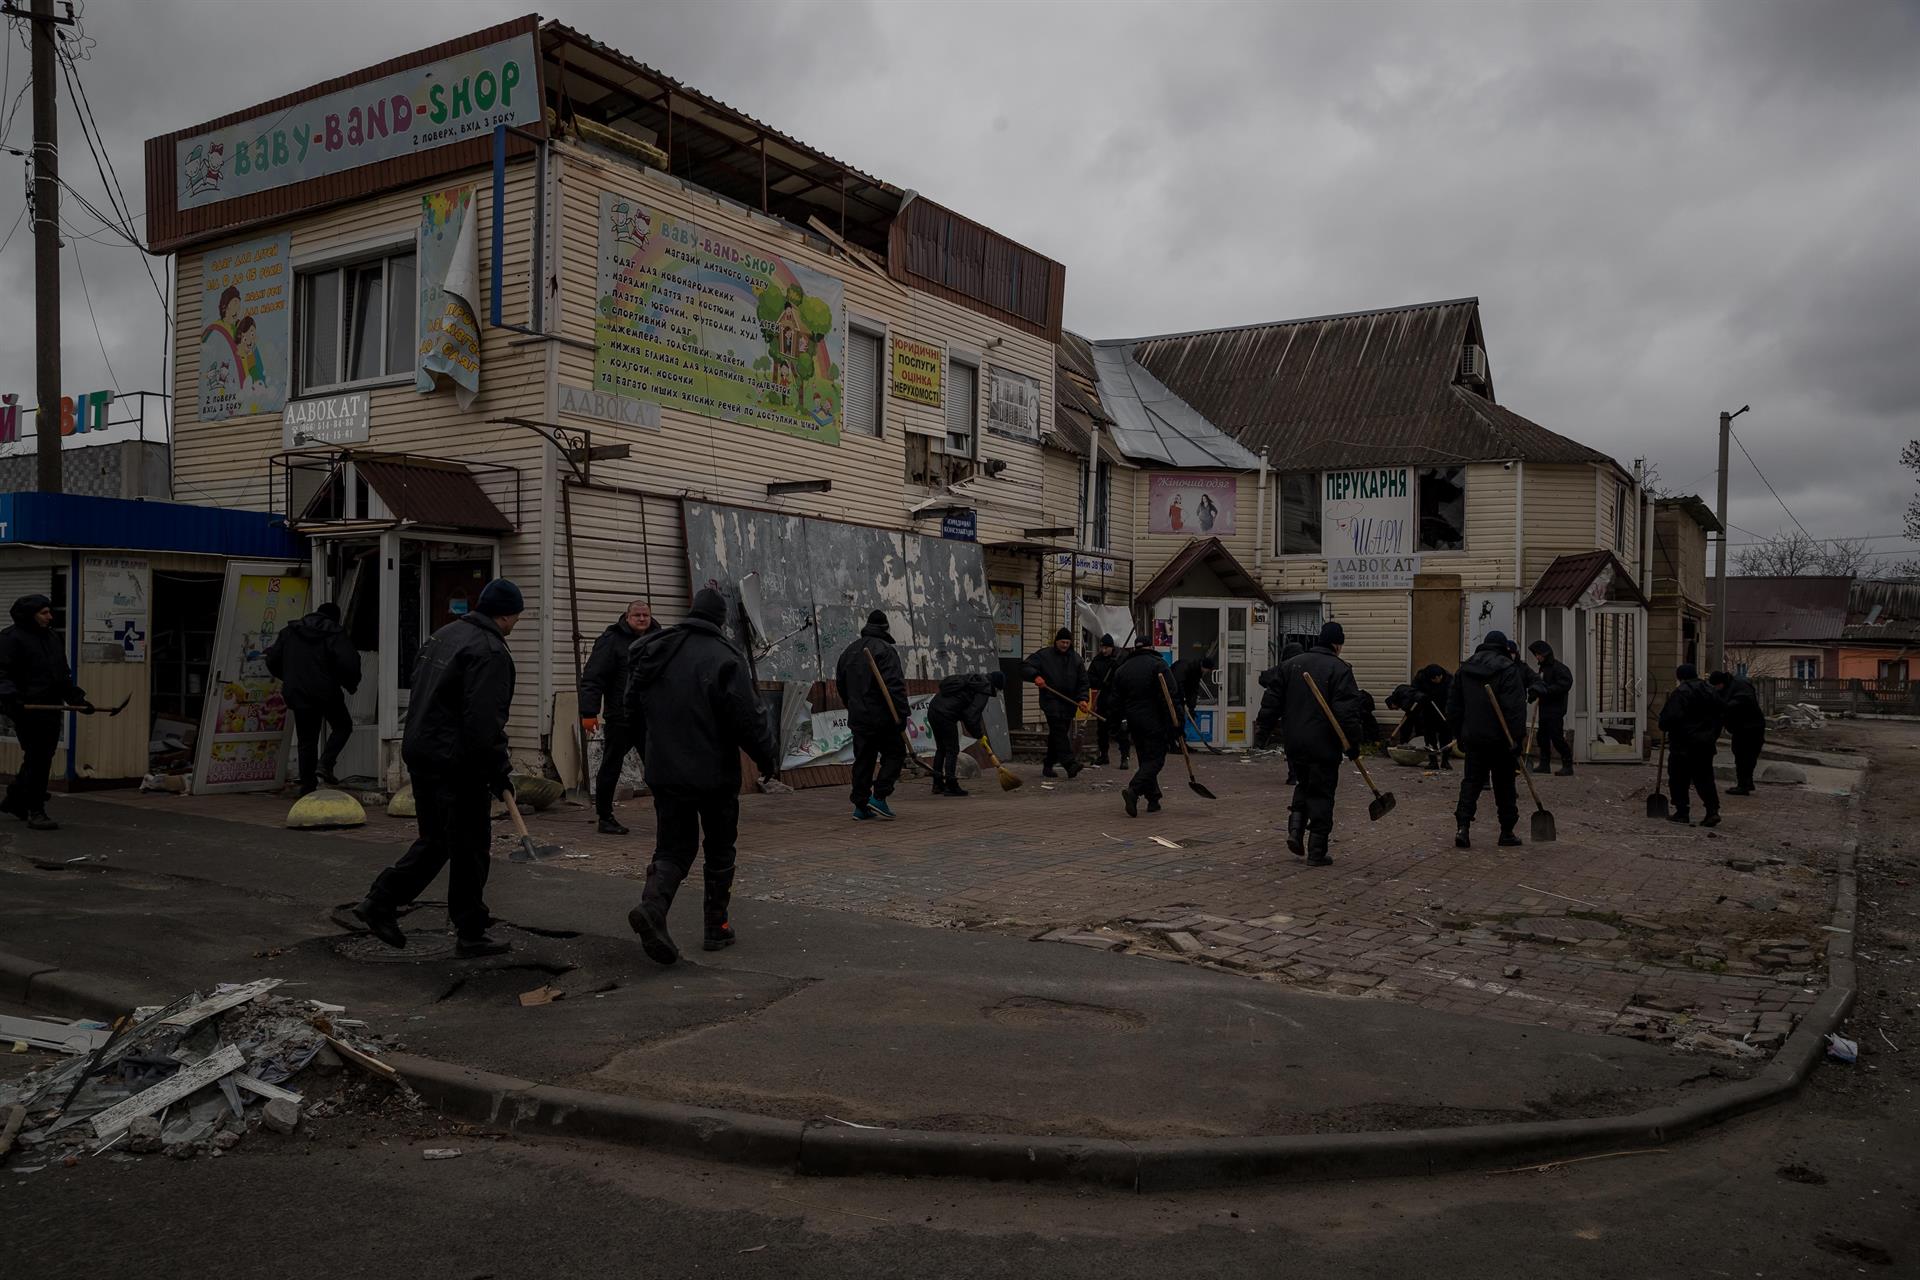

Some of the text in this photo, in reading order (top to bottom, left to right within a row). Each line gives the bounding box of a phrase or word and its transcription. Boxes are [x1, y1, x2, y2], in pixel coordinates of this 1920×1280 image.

[413, 134, 419, 145] 2
[895, 338, 939, 360] ЮРИДИЧНІ
[898, 354, 936, 373] ПОСЛУГИ
[902, 370, 932, 387] ОЦІНКА
[894, 381, 939, 402] НЕРУХОМОСТІ
[285, 396, 360, 424] АДВОКАТ
[1157, 478, 1230, 488] Жіночий одяг
[1327, 469, 1406, 500] ПЕРУКАРНЯ
[1334, 558, 1414, 572] АДВОКАТ
